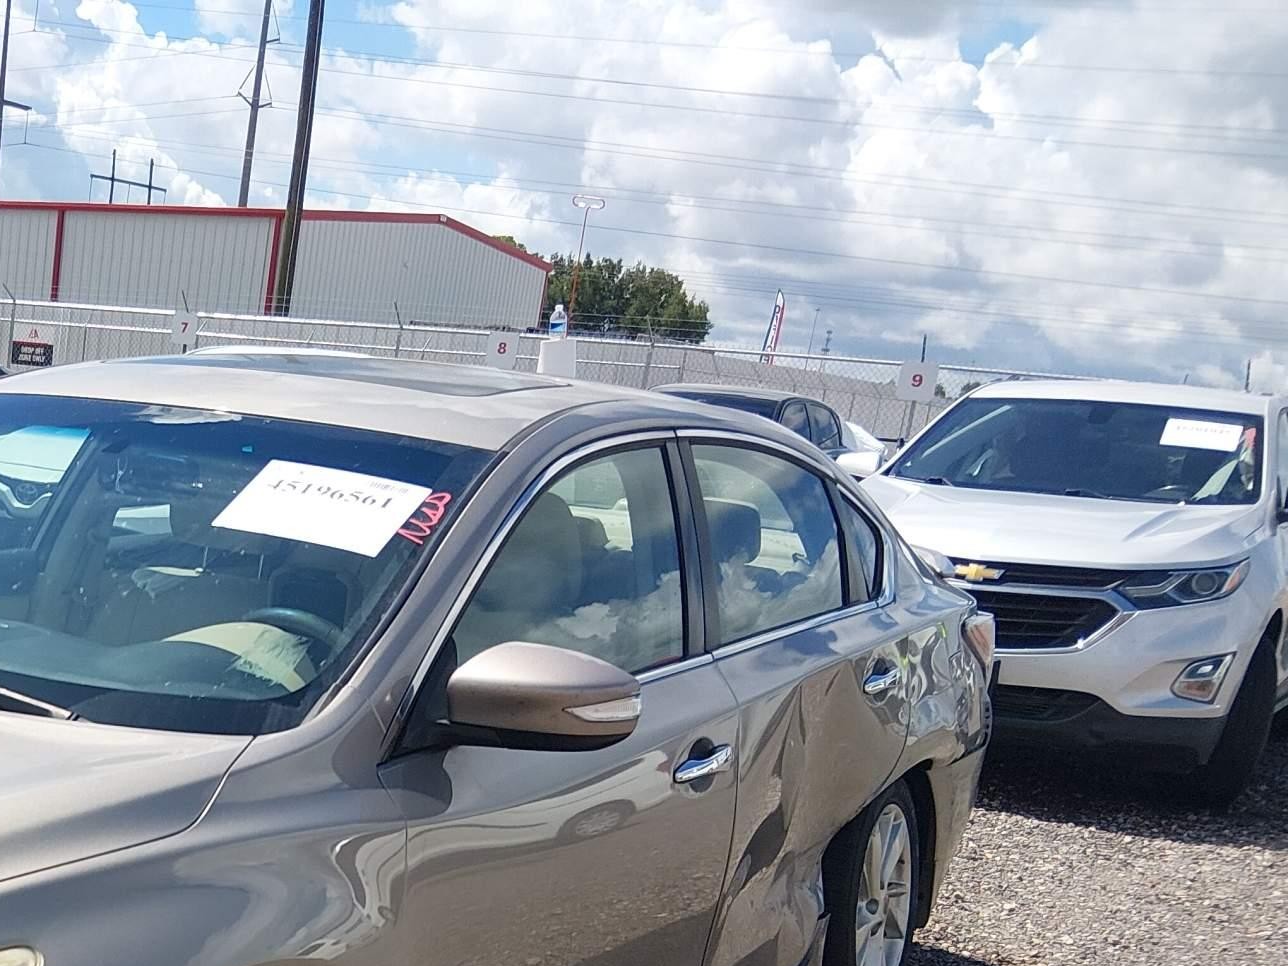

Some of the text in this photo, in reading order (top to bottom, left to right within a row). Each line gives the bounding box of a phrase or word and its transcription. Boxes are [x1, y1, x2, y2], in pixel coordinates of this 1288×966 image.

[181, 322, 188, 333] 7
[497, 342, 507, 354] 8
[911, 374, 923, 388] 9
